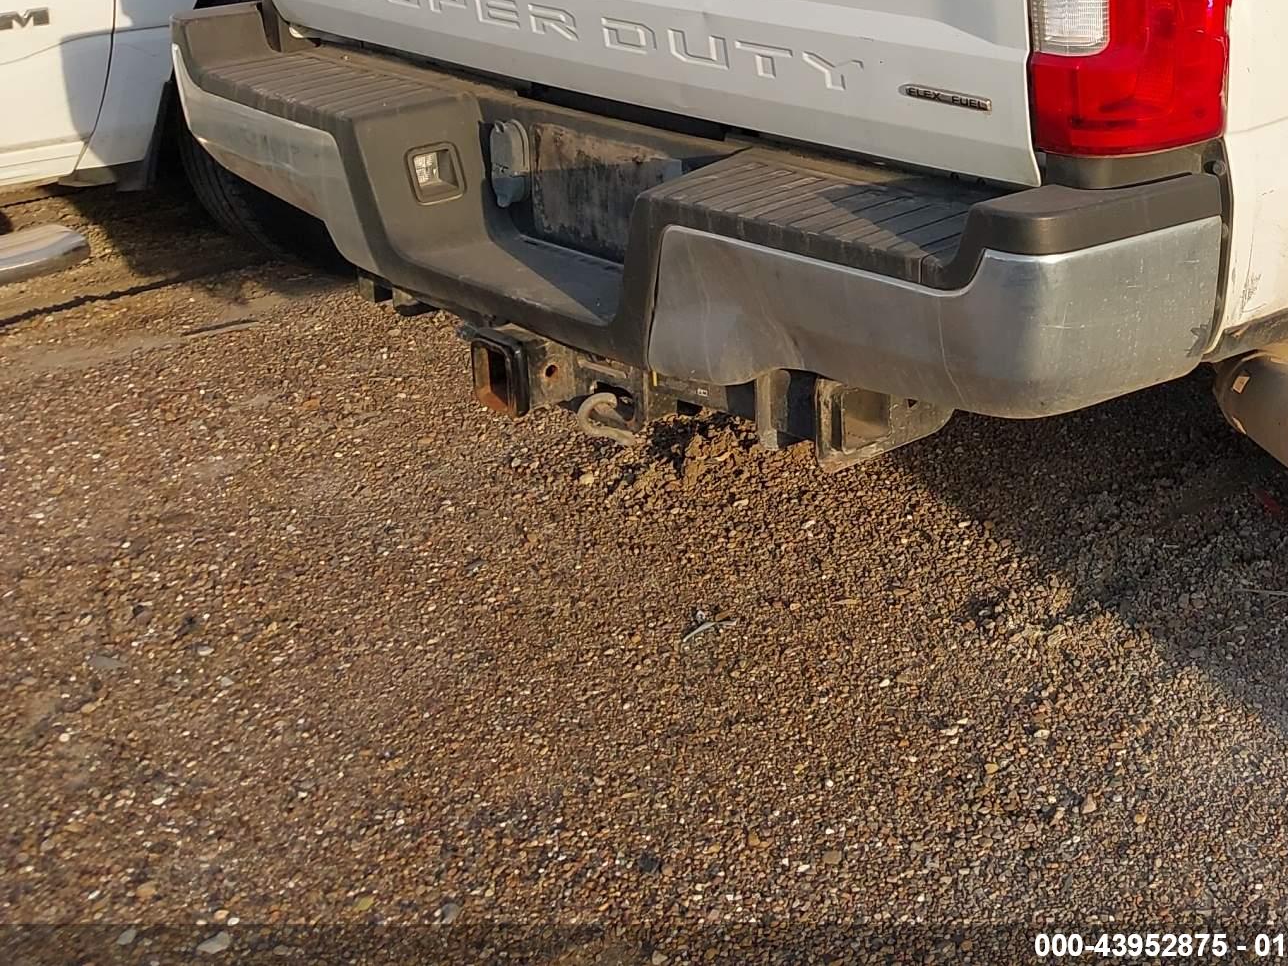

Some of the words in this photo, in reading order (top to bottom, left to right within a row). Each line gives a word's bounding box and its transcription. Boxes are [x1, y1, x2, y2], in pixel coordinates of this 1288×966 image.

[600, 16, 864, 91] DUTY
[906, 87, 941, 102] FLEX
[951, 95, 988, 112] FUEL
